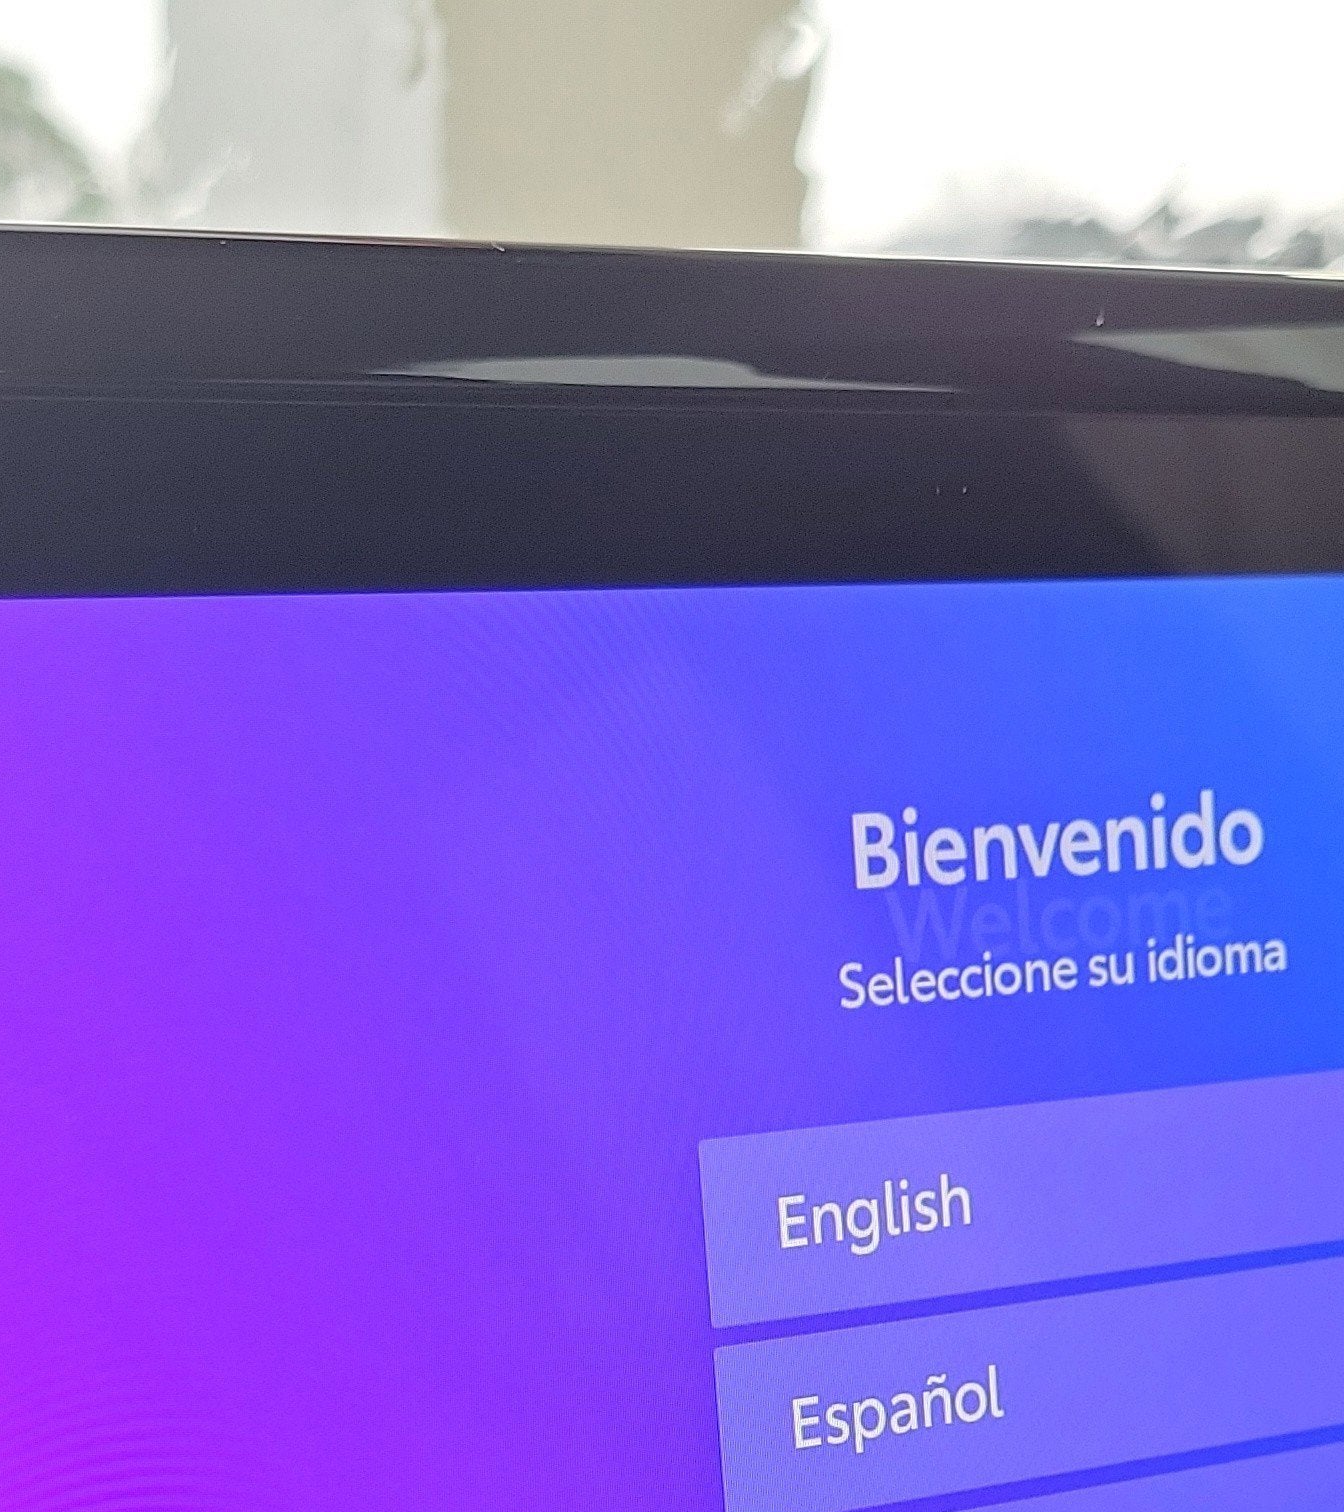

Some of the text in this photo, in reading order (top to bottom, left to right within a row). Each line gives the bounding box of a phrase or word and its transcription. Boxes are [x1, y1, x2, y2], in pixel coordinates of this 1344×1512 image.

[850, 788, 1265, 890] Bienvenido
[838, 933, 1288, 1010] Seleccione su idioma
[777, 1173, 974, 1256] English
[791, 1364, 1006, 1454] Español
